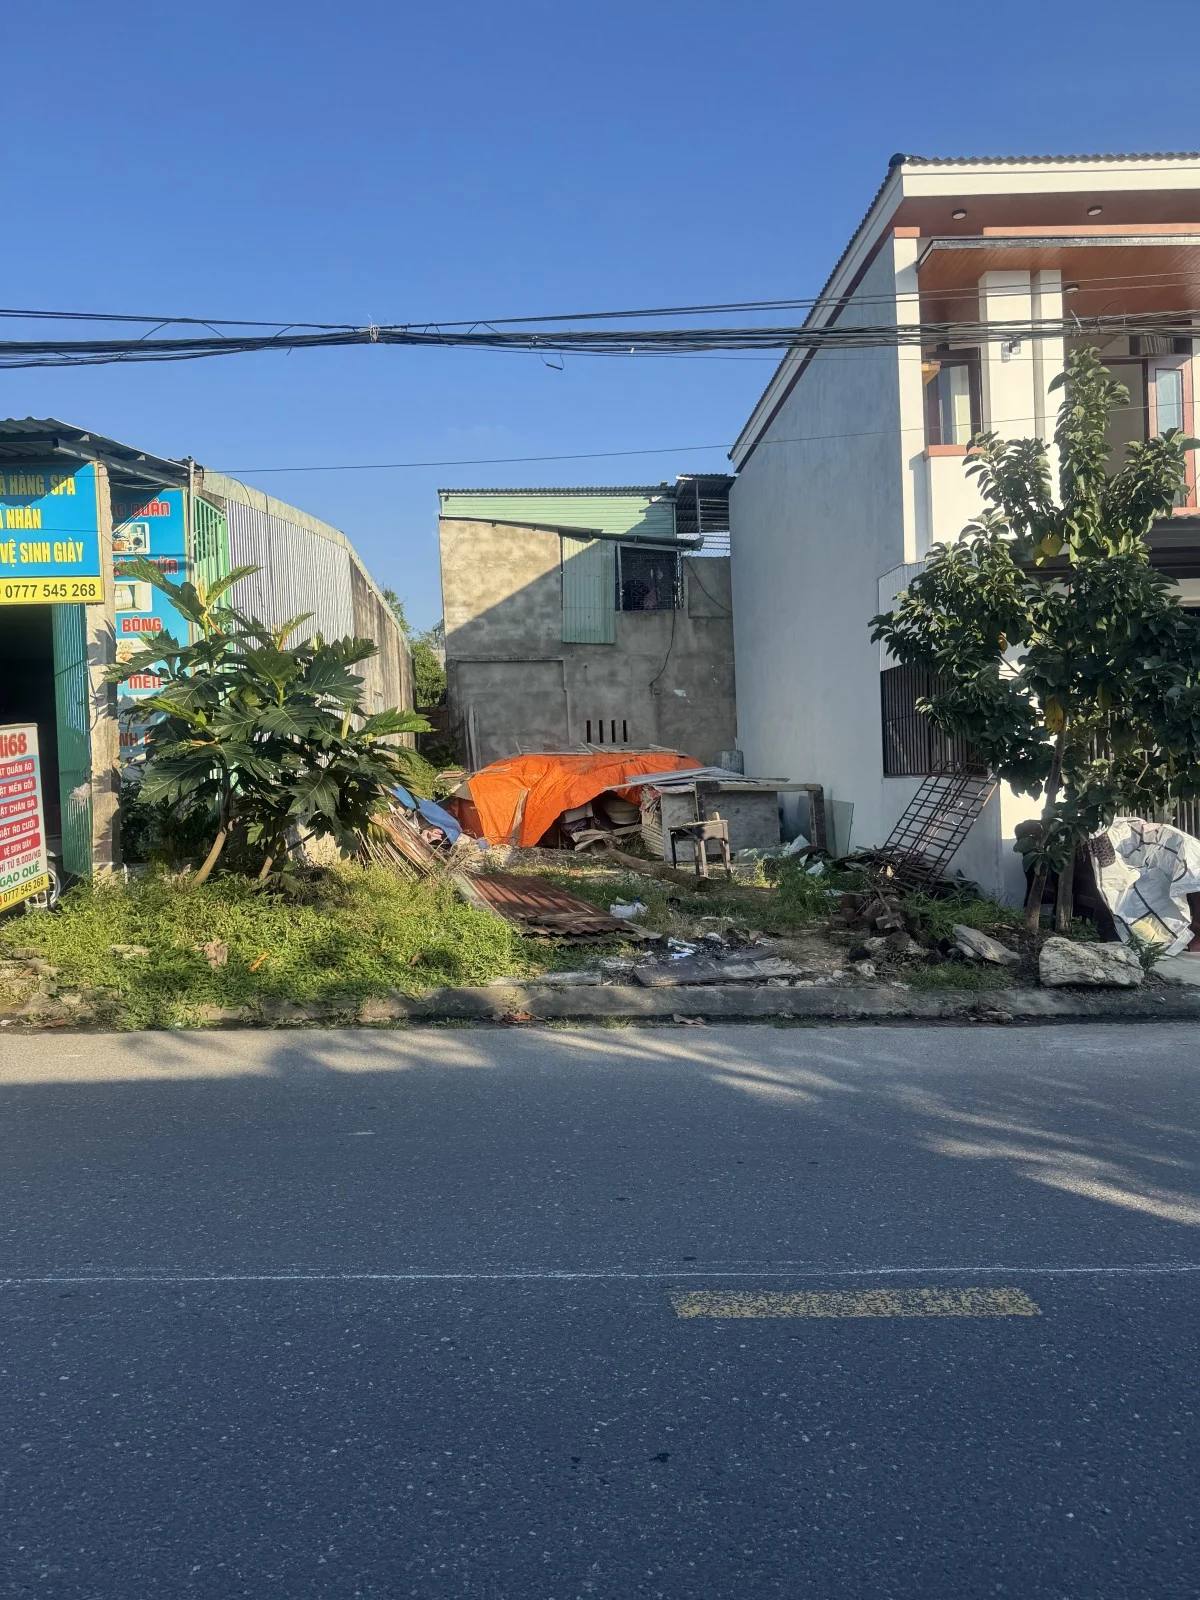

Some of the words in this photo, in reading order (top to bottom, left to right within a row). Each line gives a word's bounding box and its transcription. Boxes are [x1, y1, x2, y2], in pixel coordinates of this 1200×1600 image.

[50, 475, 76, 495] SPA
[6, 505, 42, 529] NHÂN
[0, 538, 17, 568] VỆ
[20, 542, 51, 563] SINH
[53, 536, 84, 563] GIÀY
[5, 585, 38, 598] 0777
[43, 584, 67, 597] 545
[71, 583, 96, 597] 268
[122, 615, 162, 633] BÔNG
[0, 871, 20, 887] GẠO
[22, 860, 40, 878] QUÊ
[3, 887, 19, 902] 0777
[20, 881, 32, 895] 545
